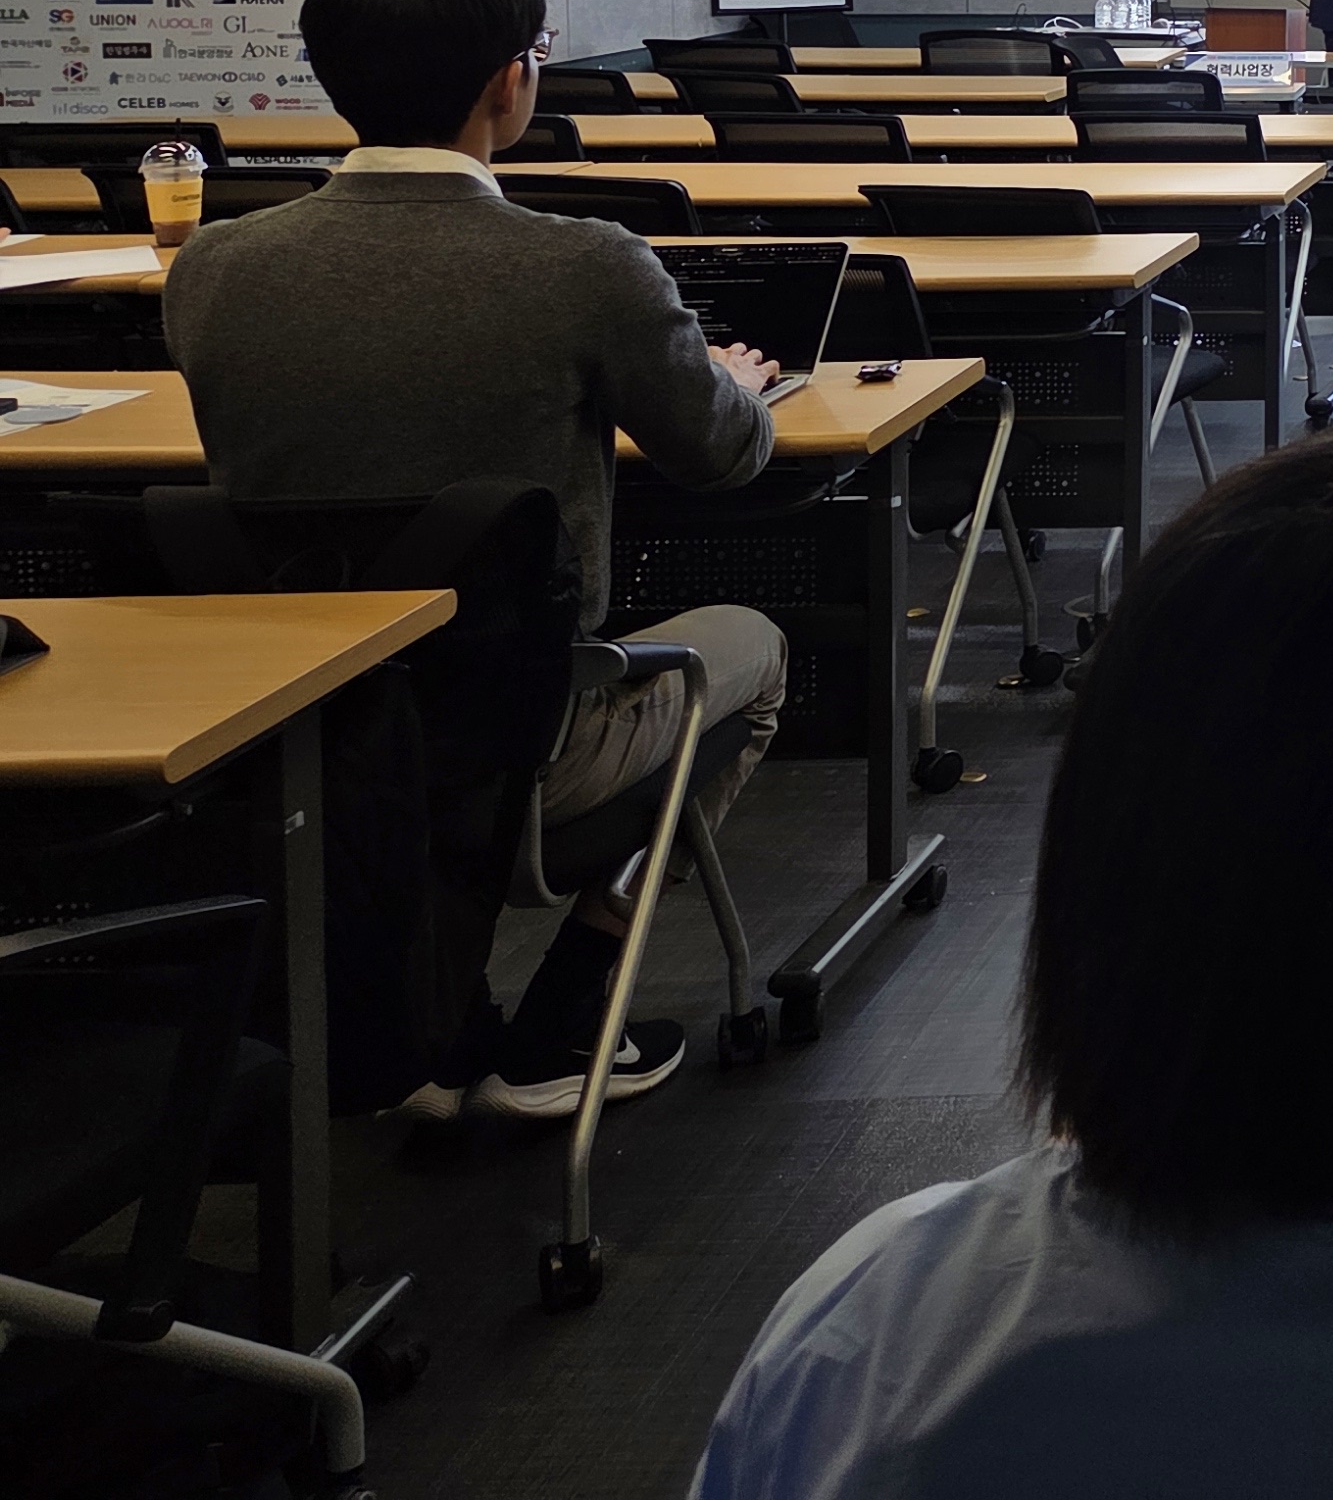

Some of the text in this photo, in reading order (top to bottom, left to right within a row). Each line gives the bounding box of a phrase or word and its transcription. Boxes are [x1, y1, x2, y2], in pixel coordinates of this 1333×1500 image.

[89, 14, 136, 26] UNION
[1207, 63, 1274, 77] 협력사업장
[70, 103, 108, 114] disco
[118, 97, 166, 109] CELEB
